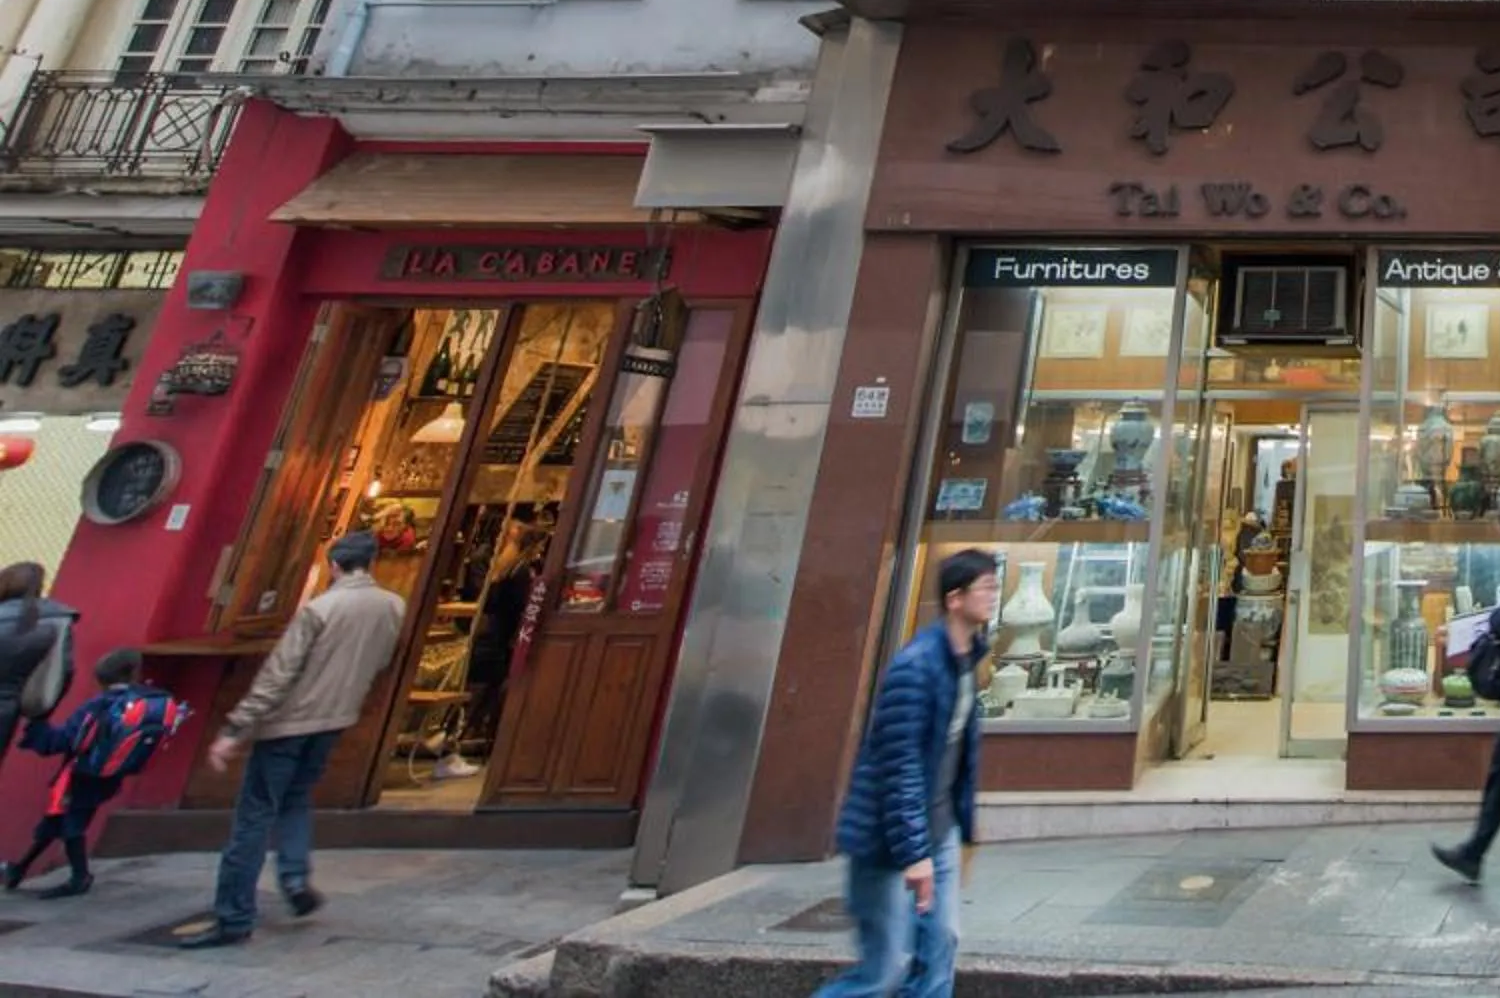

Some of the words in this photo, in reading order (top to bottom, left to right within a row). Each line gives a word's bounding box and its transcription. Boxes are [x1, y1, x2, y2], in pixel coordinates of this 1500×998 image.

[1110, 182, 1179, 218] Tai
[1201, 182, 1271, 218] Wo
[1286, 183, 1324, 219] &
[1337, 184, 1408, 220] Co.
[406, 251, 457, 274] LA
[478, 251, 641, 274] CABANE
[994, 257, 1150, 280] Furnitures
[1384, 257, 1491, 285] Antique
